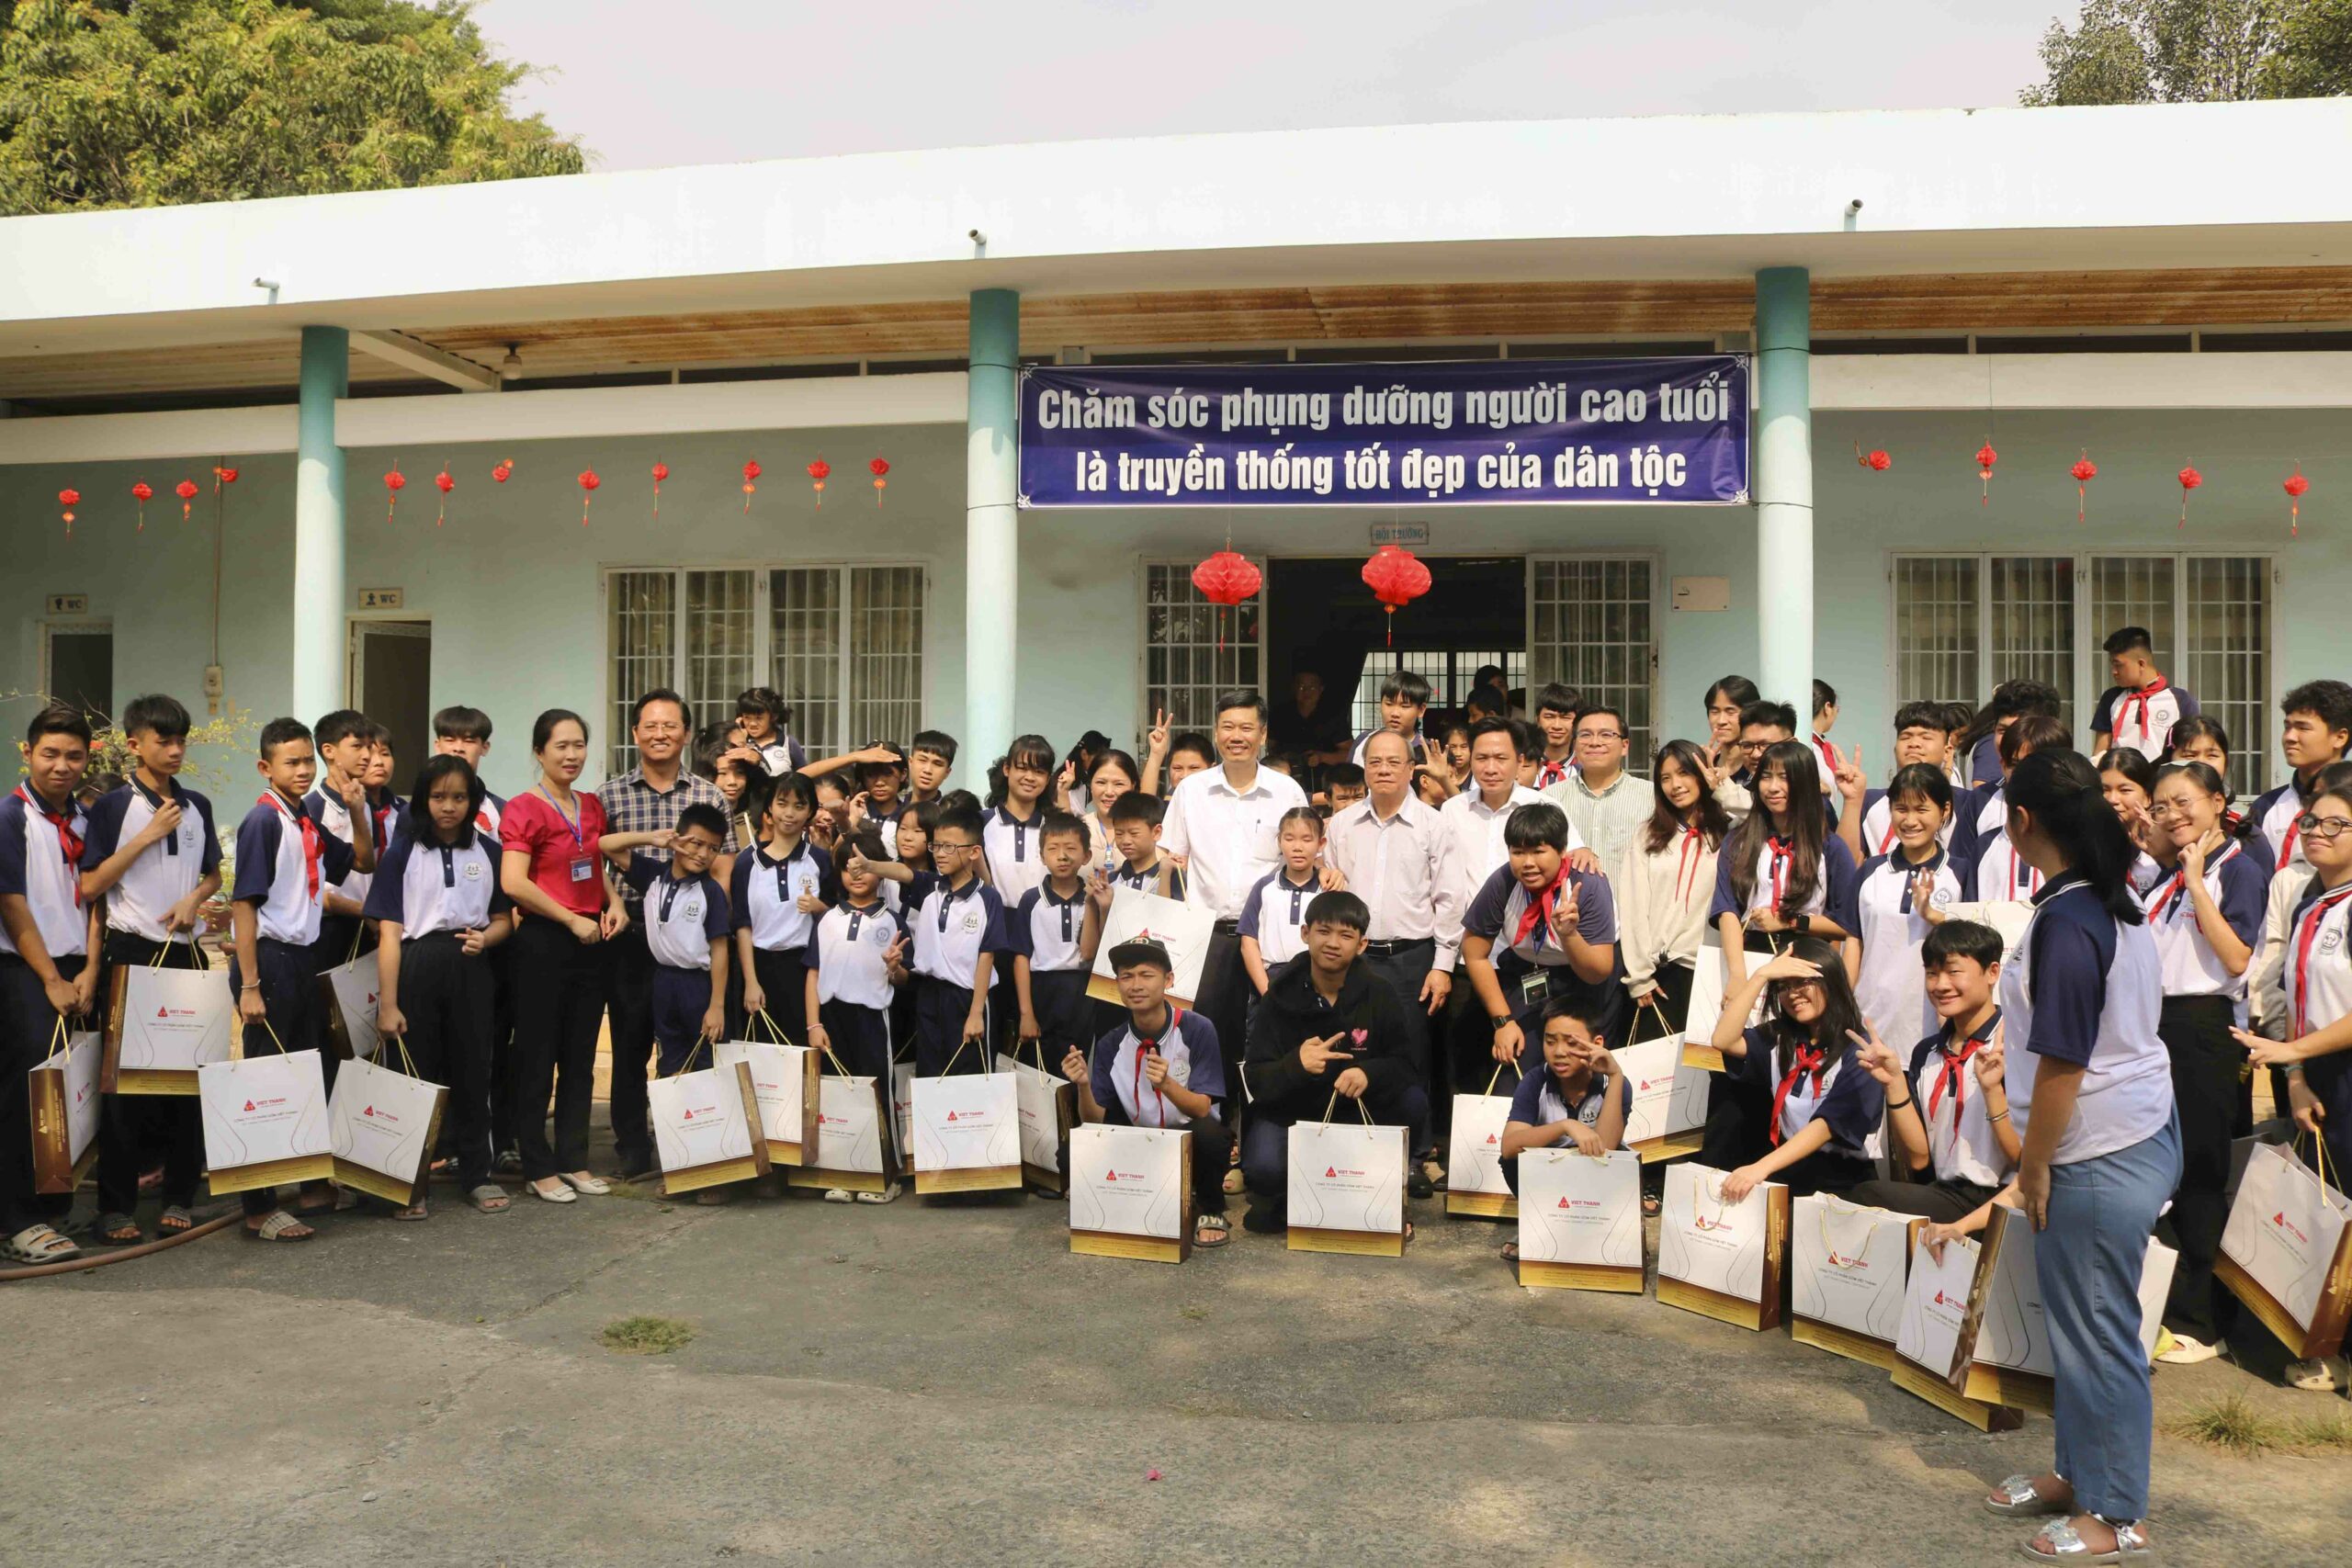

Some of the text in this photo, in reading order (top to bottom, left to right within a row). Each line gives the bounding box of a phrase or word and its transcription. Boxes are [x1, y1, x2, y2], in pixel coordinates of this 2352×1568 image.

[1039, 372, 1729, 435] Chăm sóc phụng dưỡng người cao tuổi
[1077, 440, 1688, 499] là truyền thống tốt đẹp của dân tộc
[379, 593, 397, 604] WC
